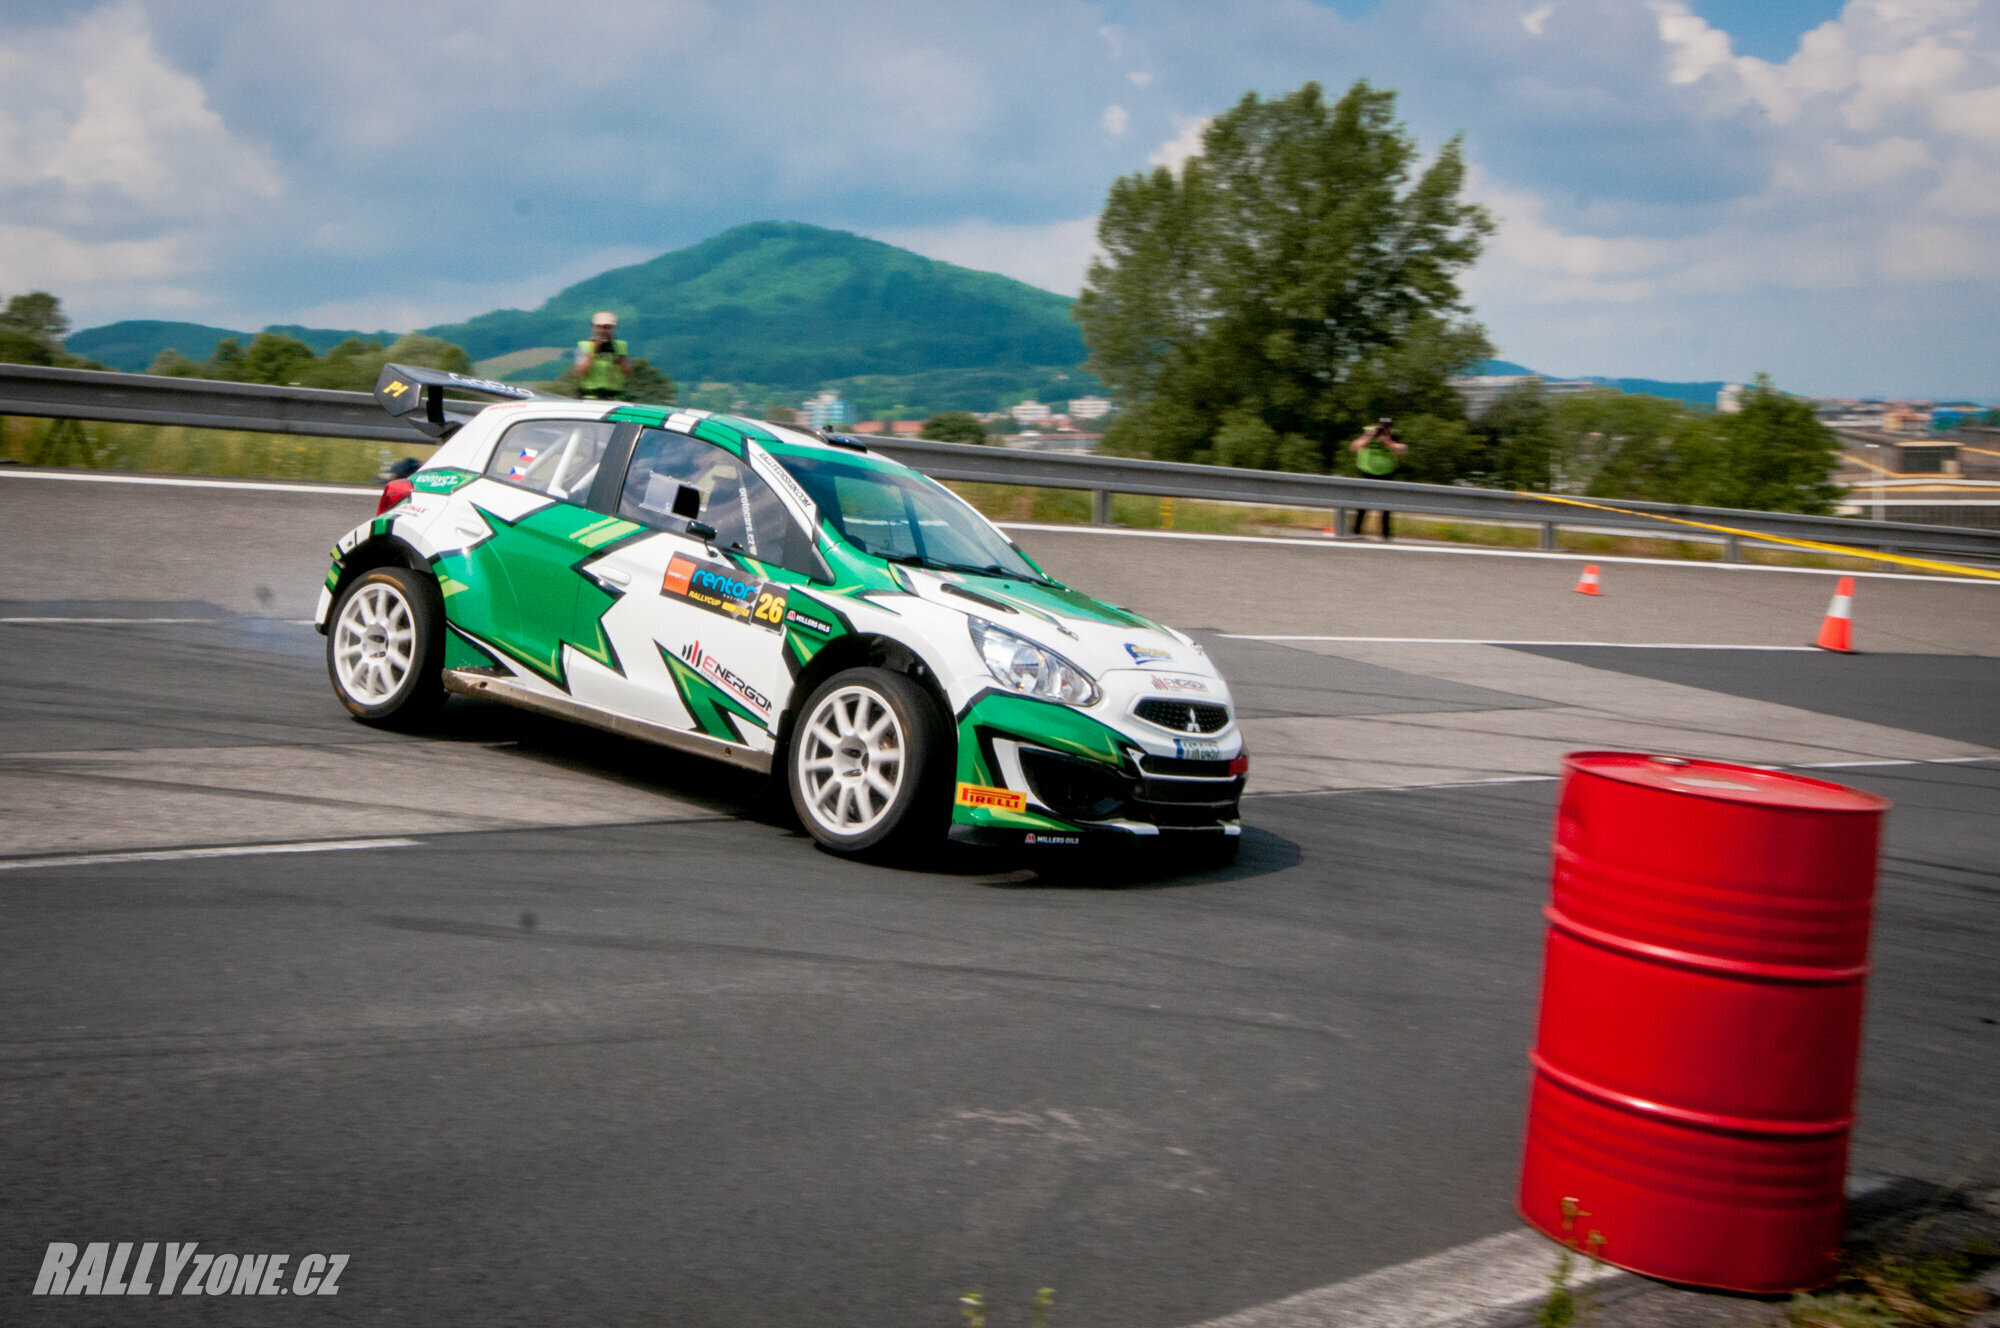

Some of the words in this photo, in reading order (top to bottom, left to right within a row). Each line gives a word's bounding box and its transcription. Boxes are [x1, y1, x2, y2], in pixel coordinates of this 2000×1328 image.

[691, 569, 756, 600] rentor
[688, 590, 722, 607] RALLYCUP
[754, 592, 786, 624] 26
[795, 614, 819, 629] MILLERS
[818, 622, 831, 633] OILS
[962, 787, 1021, 809] PIRELLI
[1036, 836, 1065, 844] MILLERS
[1065, 837, 1080, 845] OILS
